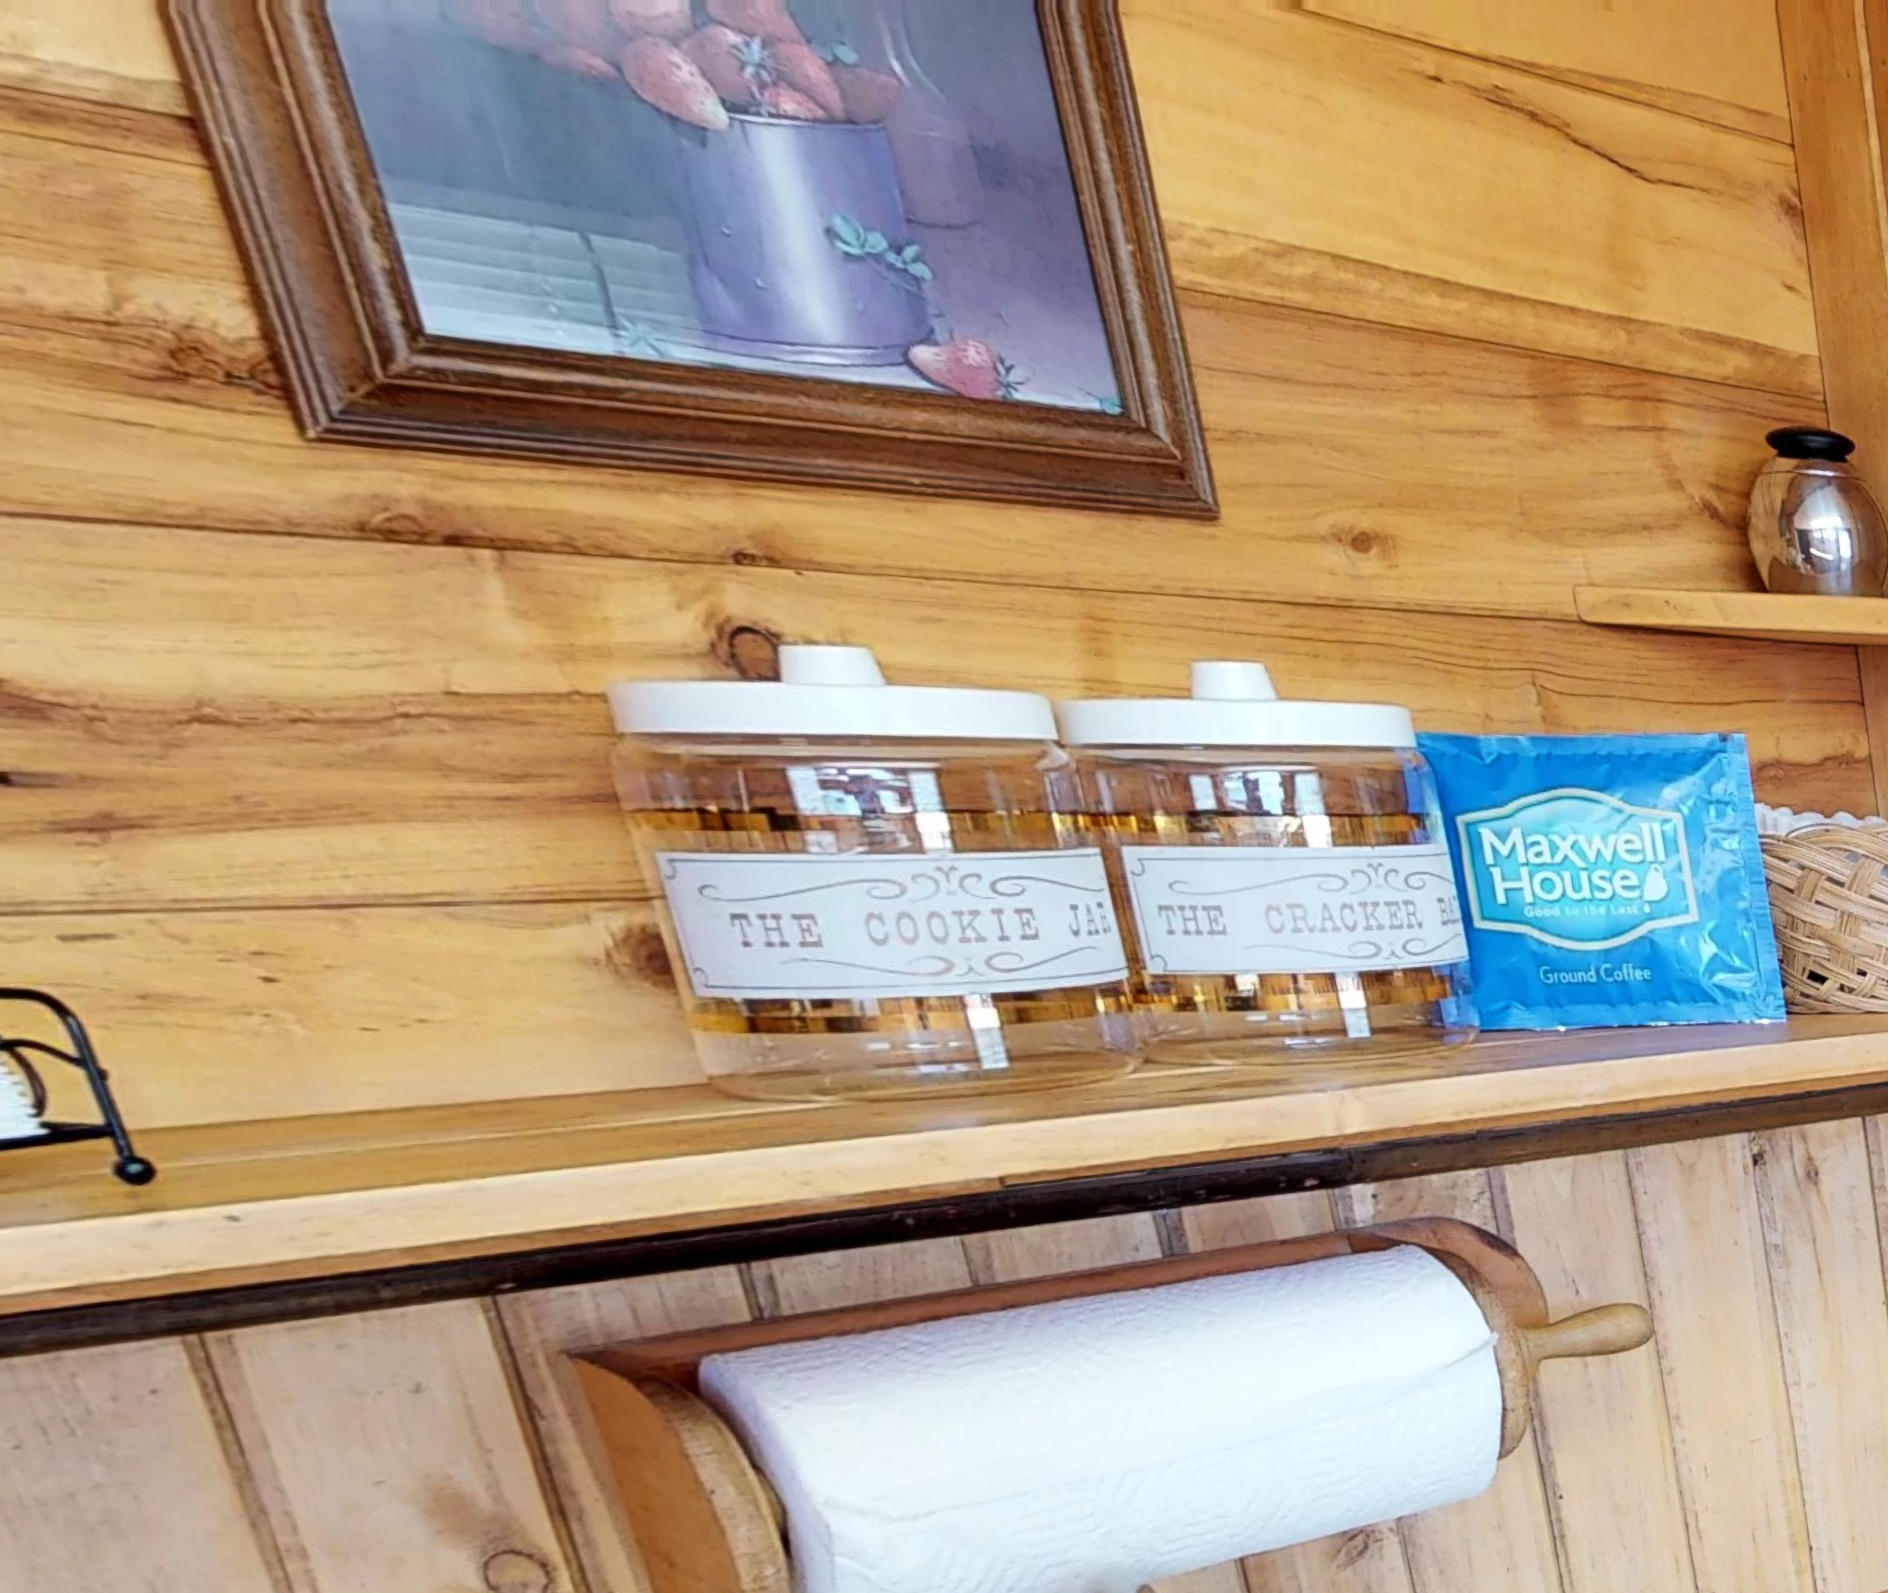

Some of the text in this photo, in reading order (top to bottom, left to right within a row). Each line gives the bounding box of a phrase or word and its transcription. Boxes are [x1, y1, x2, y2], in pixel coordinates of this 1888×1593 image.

[1478, 822, 1667, 869] Maxwell
[1488, 865, 1641, 905] House
[729, 911, 824, 949] THE
[864, 907, 1040, 946] COOKIE
[1157, 903, 1228, 937] THE
[1264, 900, 1425, 935] CRACKER
[1524, 905, 1562, 918] Good
[1539, 962, 1653, 985] Ground Coffee
